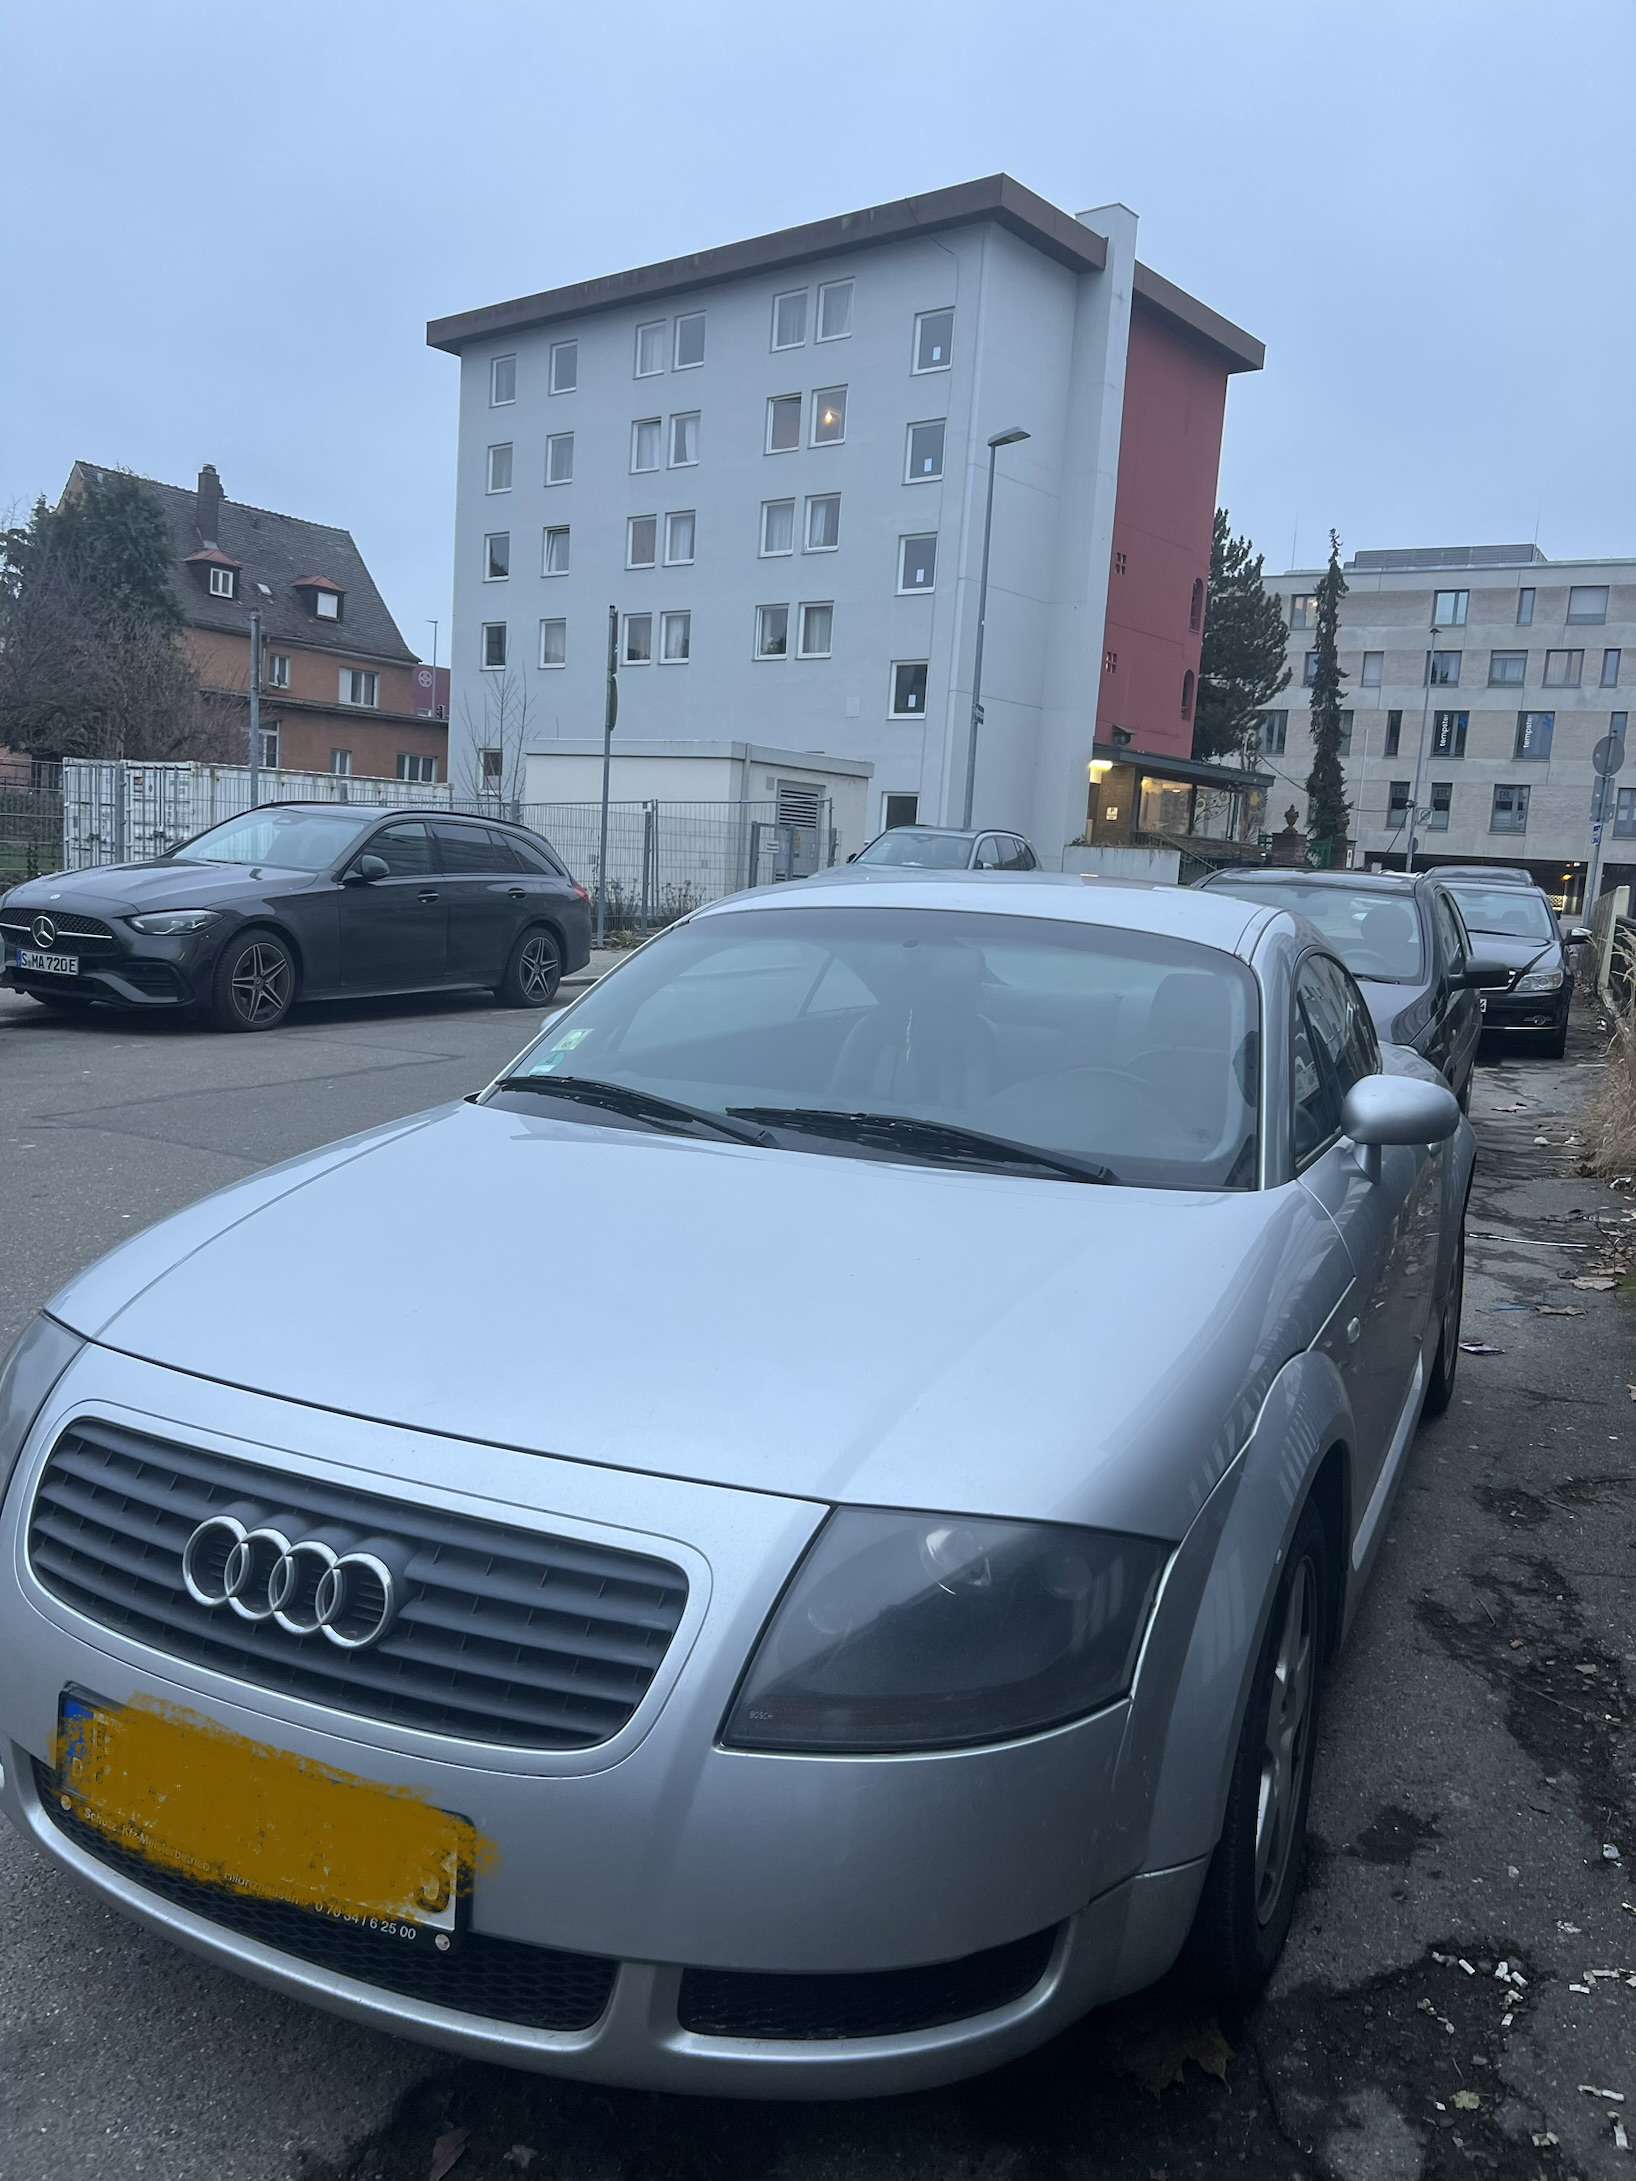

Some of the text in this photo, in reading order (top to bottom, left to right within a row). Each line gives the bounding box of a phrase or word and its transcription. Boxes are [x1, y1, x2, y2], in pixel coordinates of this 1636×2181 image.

[21, 952, 77, 973] S MA 720E
[370, 1917, 378, 1930] 6
[381, 1921, 397, 1935] 25
[400, 1925, 417, 1940] 00
